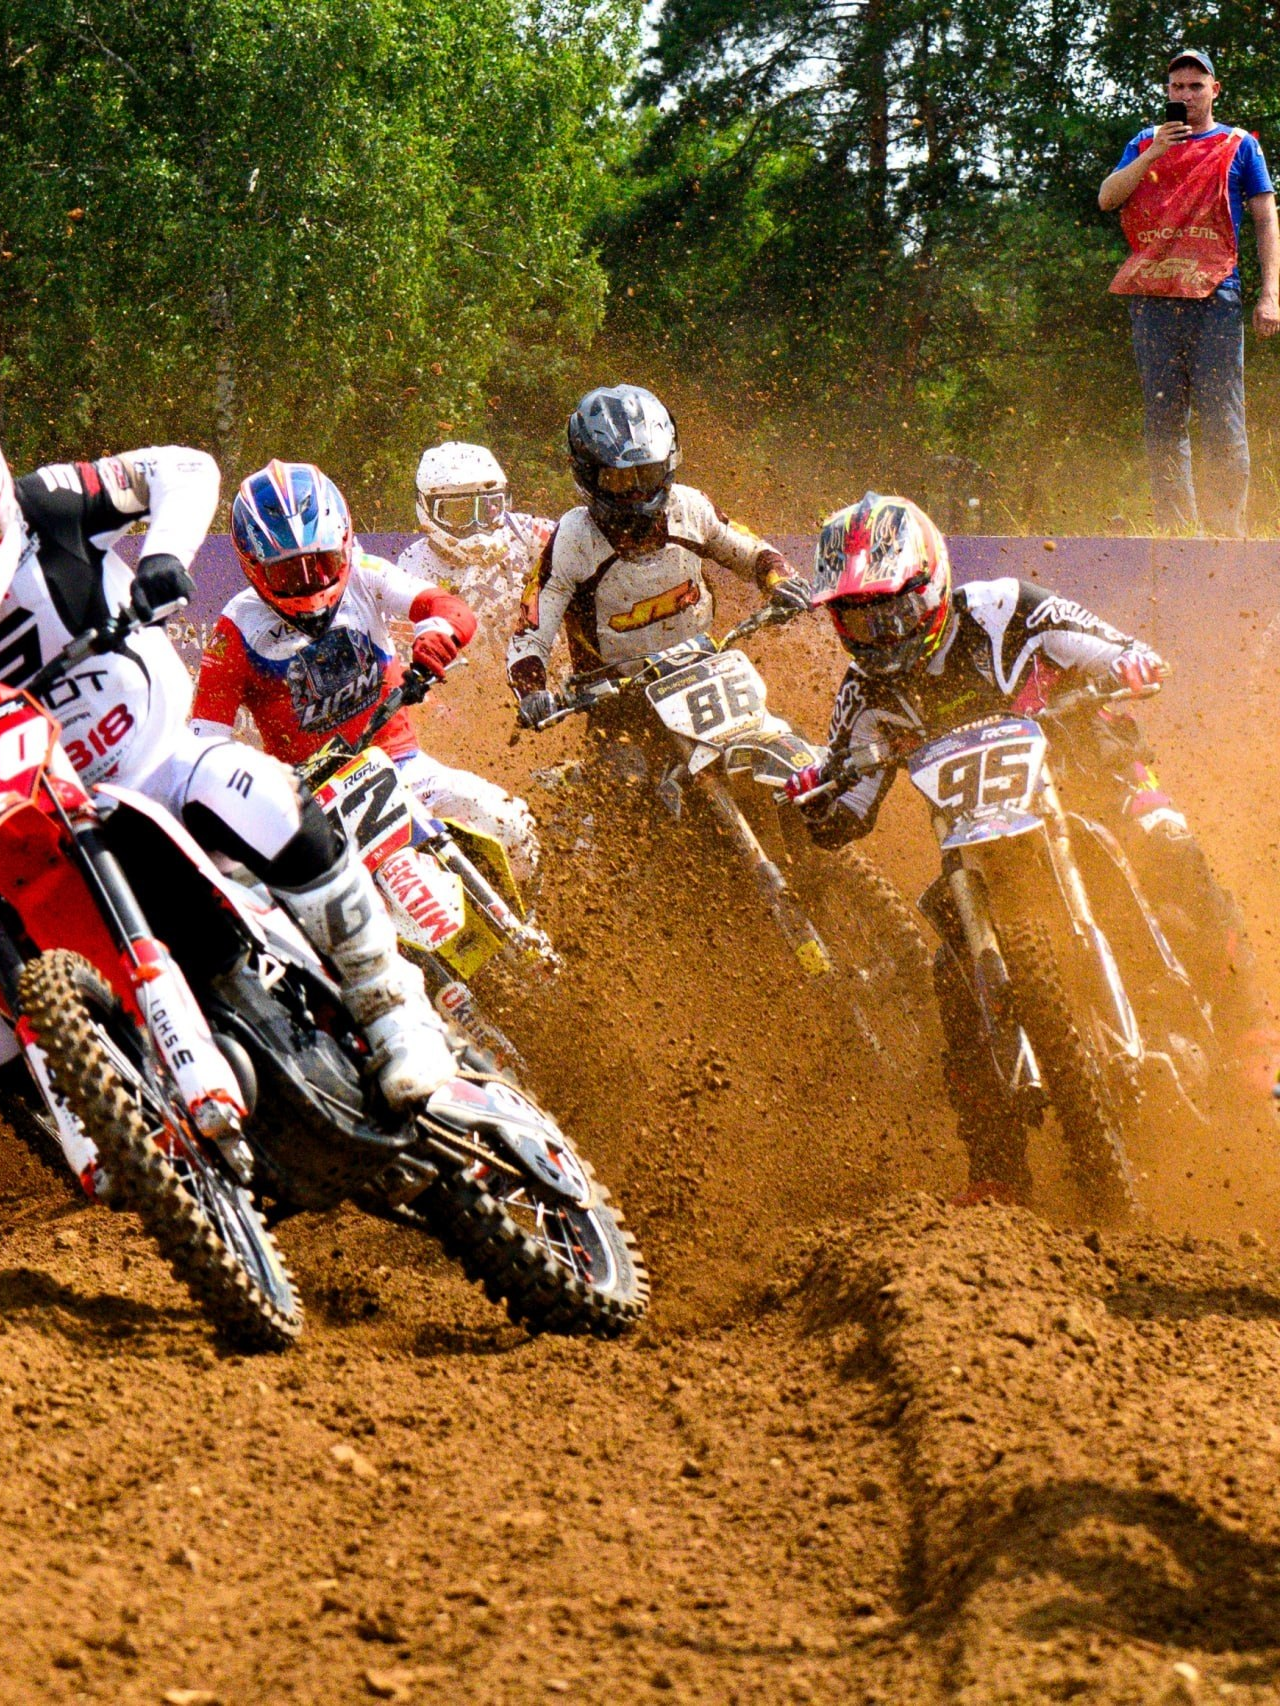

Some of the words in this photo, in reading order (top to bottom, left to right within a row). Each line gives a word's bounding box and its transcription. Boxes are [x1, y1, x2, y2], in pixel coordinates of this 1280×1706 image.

[686, 671, 761, 735] 86
[66, 703, 135, 772] 318
[938, 742, 1032, 808] 95
